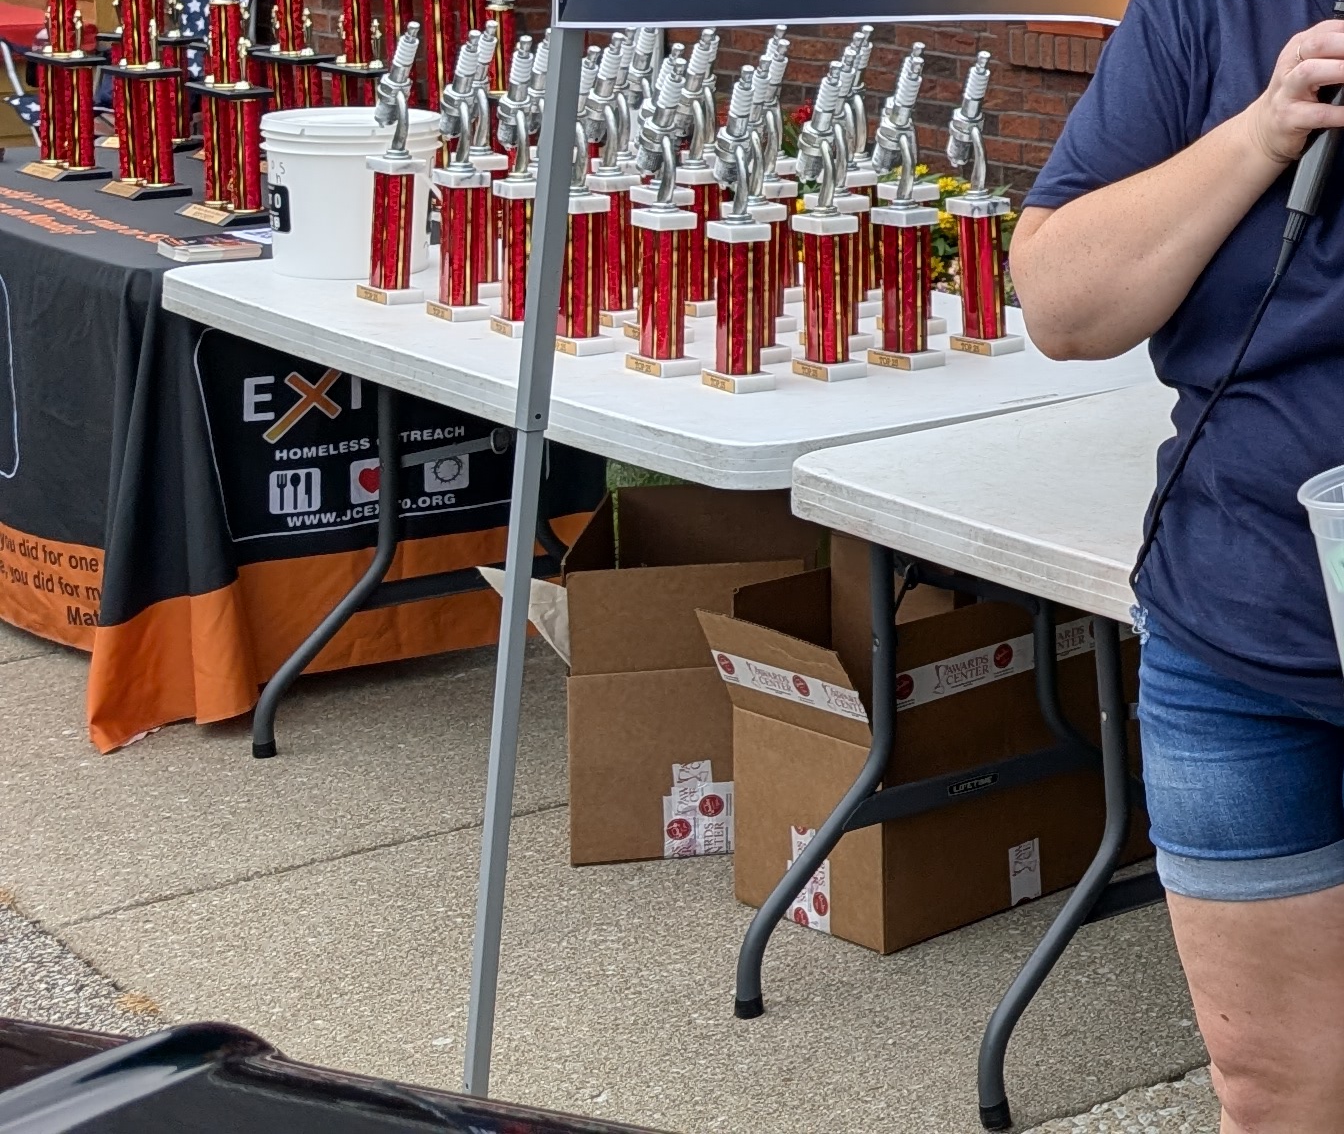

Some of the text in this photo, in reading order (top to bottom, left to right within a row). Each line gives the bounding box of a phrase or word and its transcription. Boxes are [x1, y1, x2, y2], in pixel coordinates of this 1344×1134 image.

[275, 425, 466, 461] HOMELESS TREACH
[19, 538, 42, 563] did
[42, 545, 64, 568] for
[69, 555, 100, 573] one
[33, 570, 55, 594] did
[58, 577, 81, 599] for
[1057, 625, 1085, 641] ARDS
[945, 655, 989, 675] AWARDS
[946, 665, 990, 686] CENTER
[834, 698, 866, 714] CENTE
